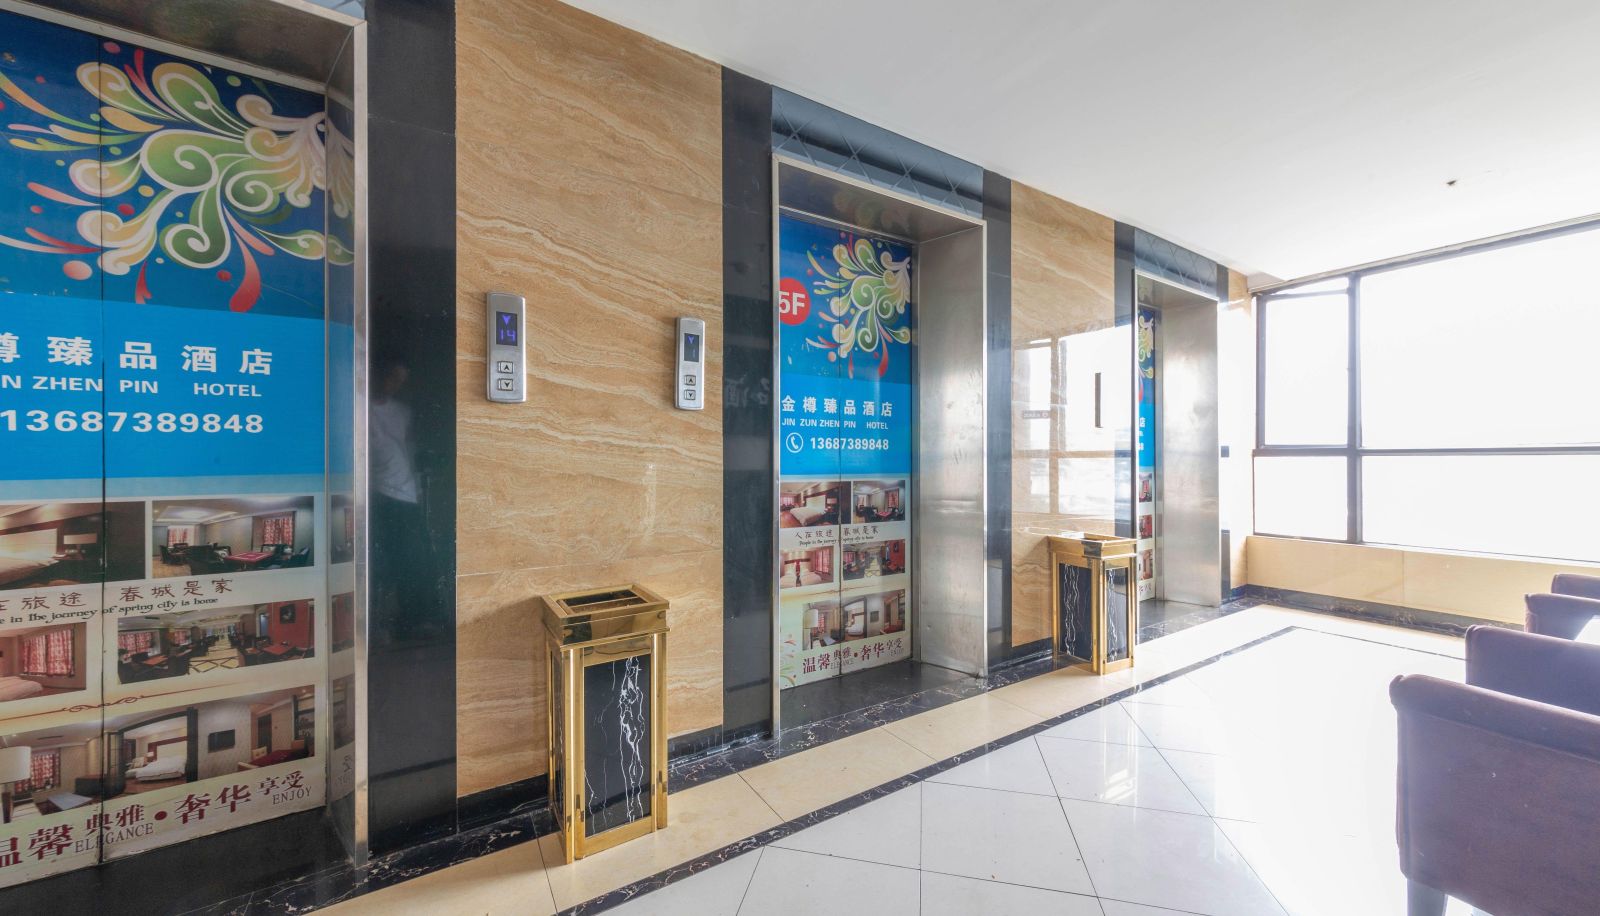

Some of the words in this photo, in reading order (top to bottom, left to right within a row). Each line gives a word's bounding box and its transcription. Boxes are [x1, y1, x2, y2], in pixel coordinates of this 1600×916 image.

[779, 290, 806, 316] 5F
[501, 328, 516, 342] 14
[33, 376, 103, 392] ZHEN
[119, 380, 159, 394] PIN
[193, 383, 262, 397] HOTEL
[0, 409, 264, 434] 13687389848
[781, 418, 796, 427] JIN
[800, 418, 817, 427] ZUN
[819, 419, 840, 428] ZHEN
[843, 420, 856, 429] PIN
[866, 421, 889, 430] HOTEL
[810, 437, 889, 450] 13687389848
[119, 578, 232, 602] 春城是家
[29, 613, 47, 621] the
[46, 609, 98, 624] journey
[118, 604, 154, 616] spring
[157, 600, 178, 611] city
[194, 597, 219, 605] home
[272, 786, 312, 805] ENJOY
